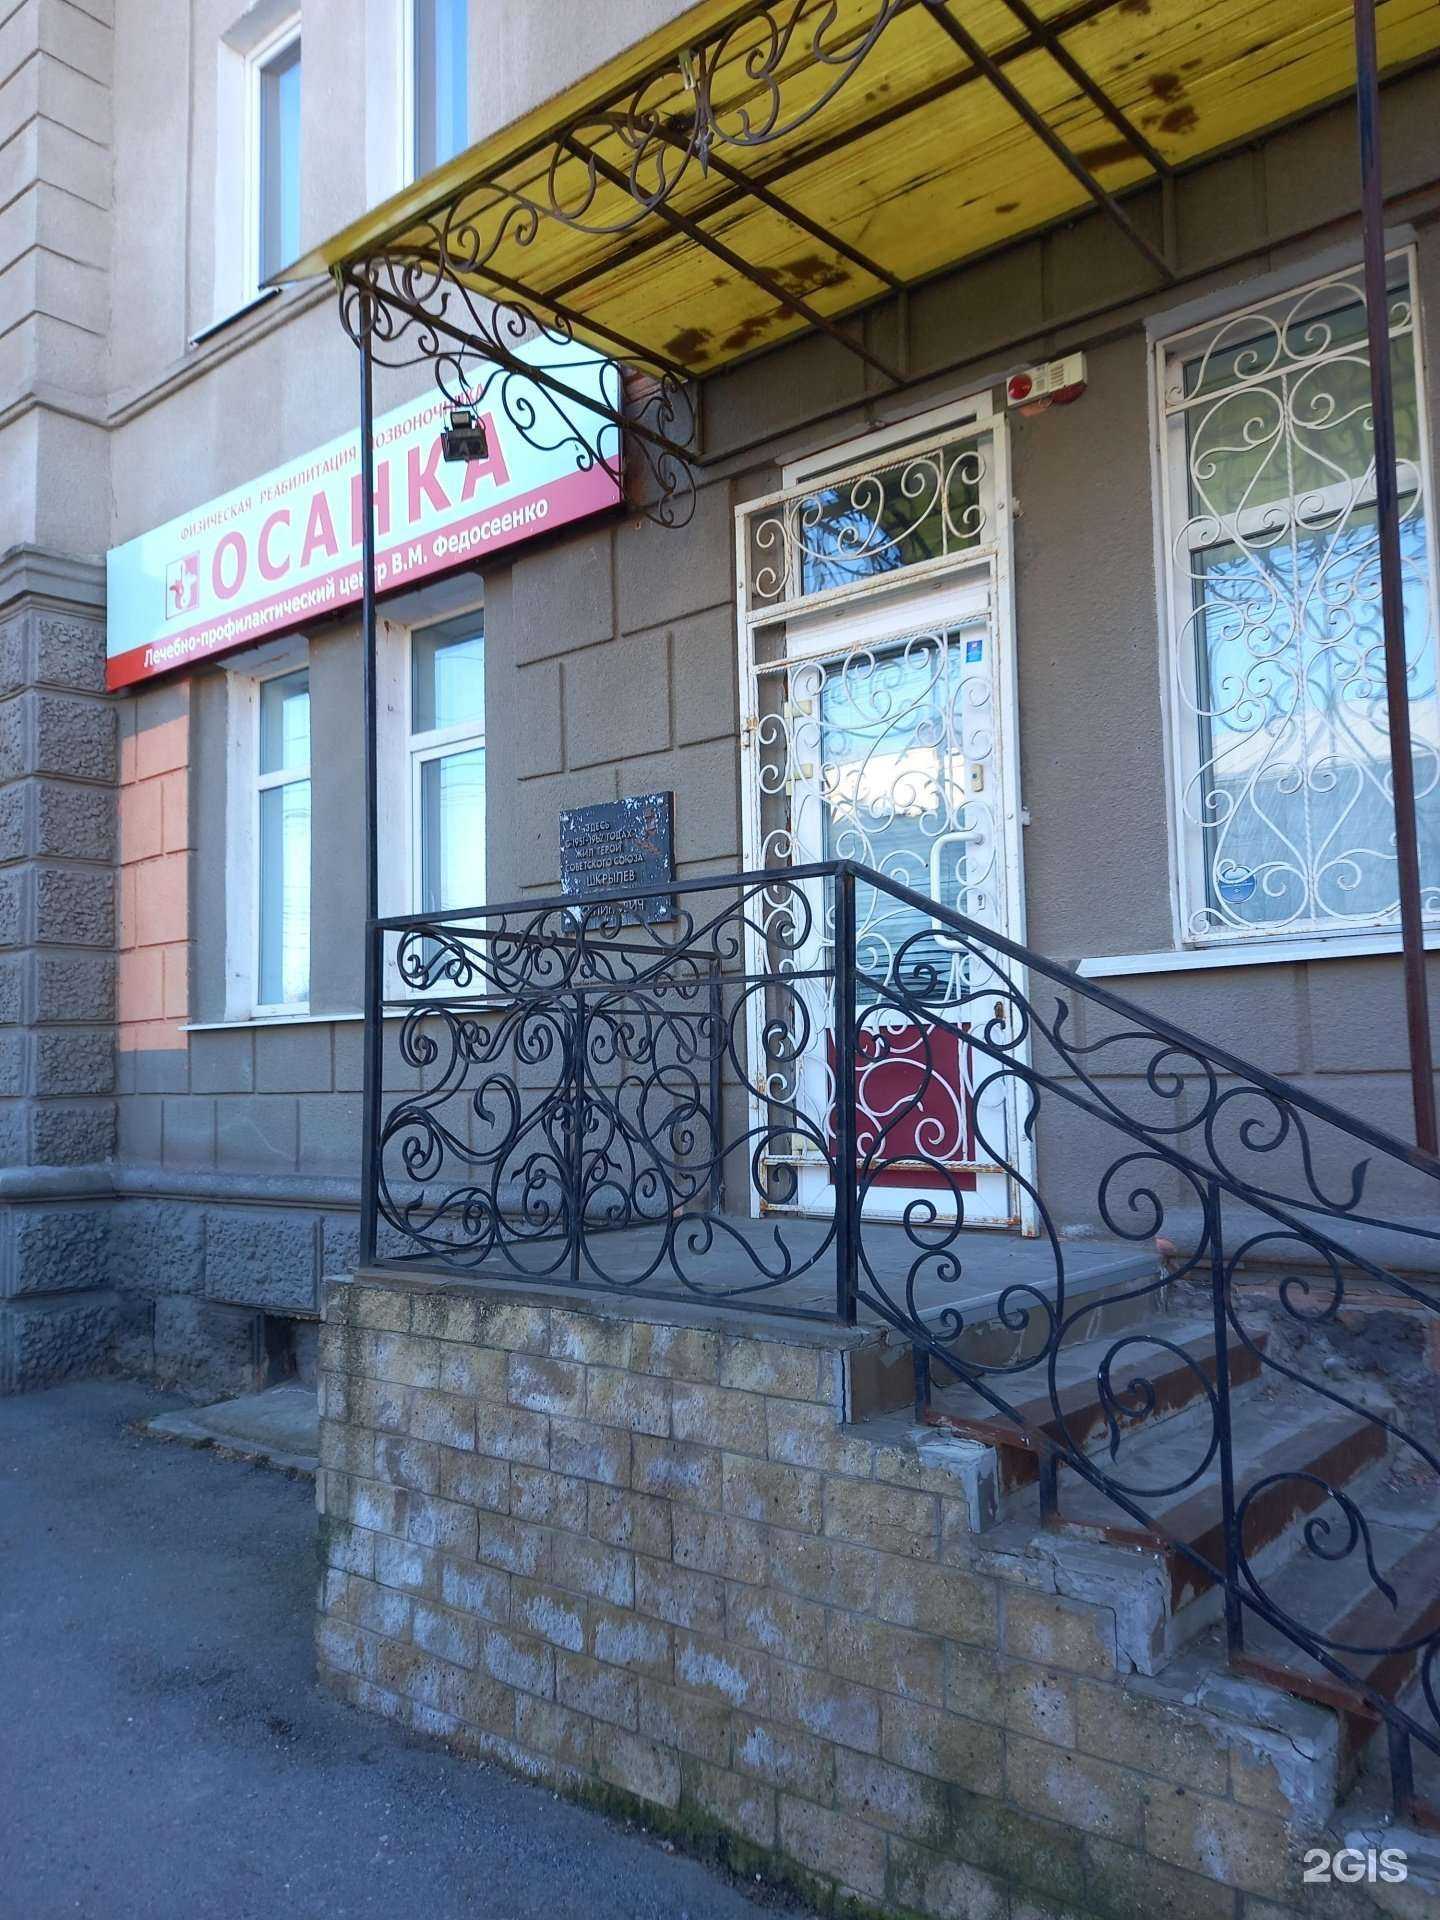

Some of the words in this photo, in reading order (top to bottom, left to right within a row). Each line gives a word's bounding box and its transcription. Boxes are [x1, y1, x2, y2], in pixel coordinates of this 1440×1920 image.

[180, 497, 252, 541] ФИЗИЧЕСКАЯ
[260, 445, 357, 504] РЕАБИЛИТАЦИЯ
[372, 383, 484, 450] ОЗВОНОЧНИКА
[211, 411, 510, 600] ОСАНКА
[143, 576, 336, 669] Лечебно-профилактический
[391, 543, 428, 576] В.М.
[432, 498, 548, 558] Федосеенко
[565, 857, 612, 872] СОВЕТСКОГО
[613, 854, 643, 865] СОЮЗА
[584, 820, 610, 832] ЗДЕСЬ
